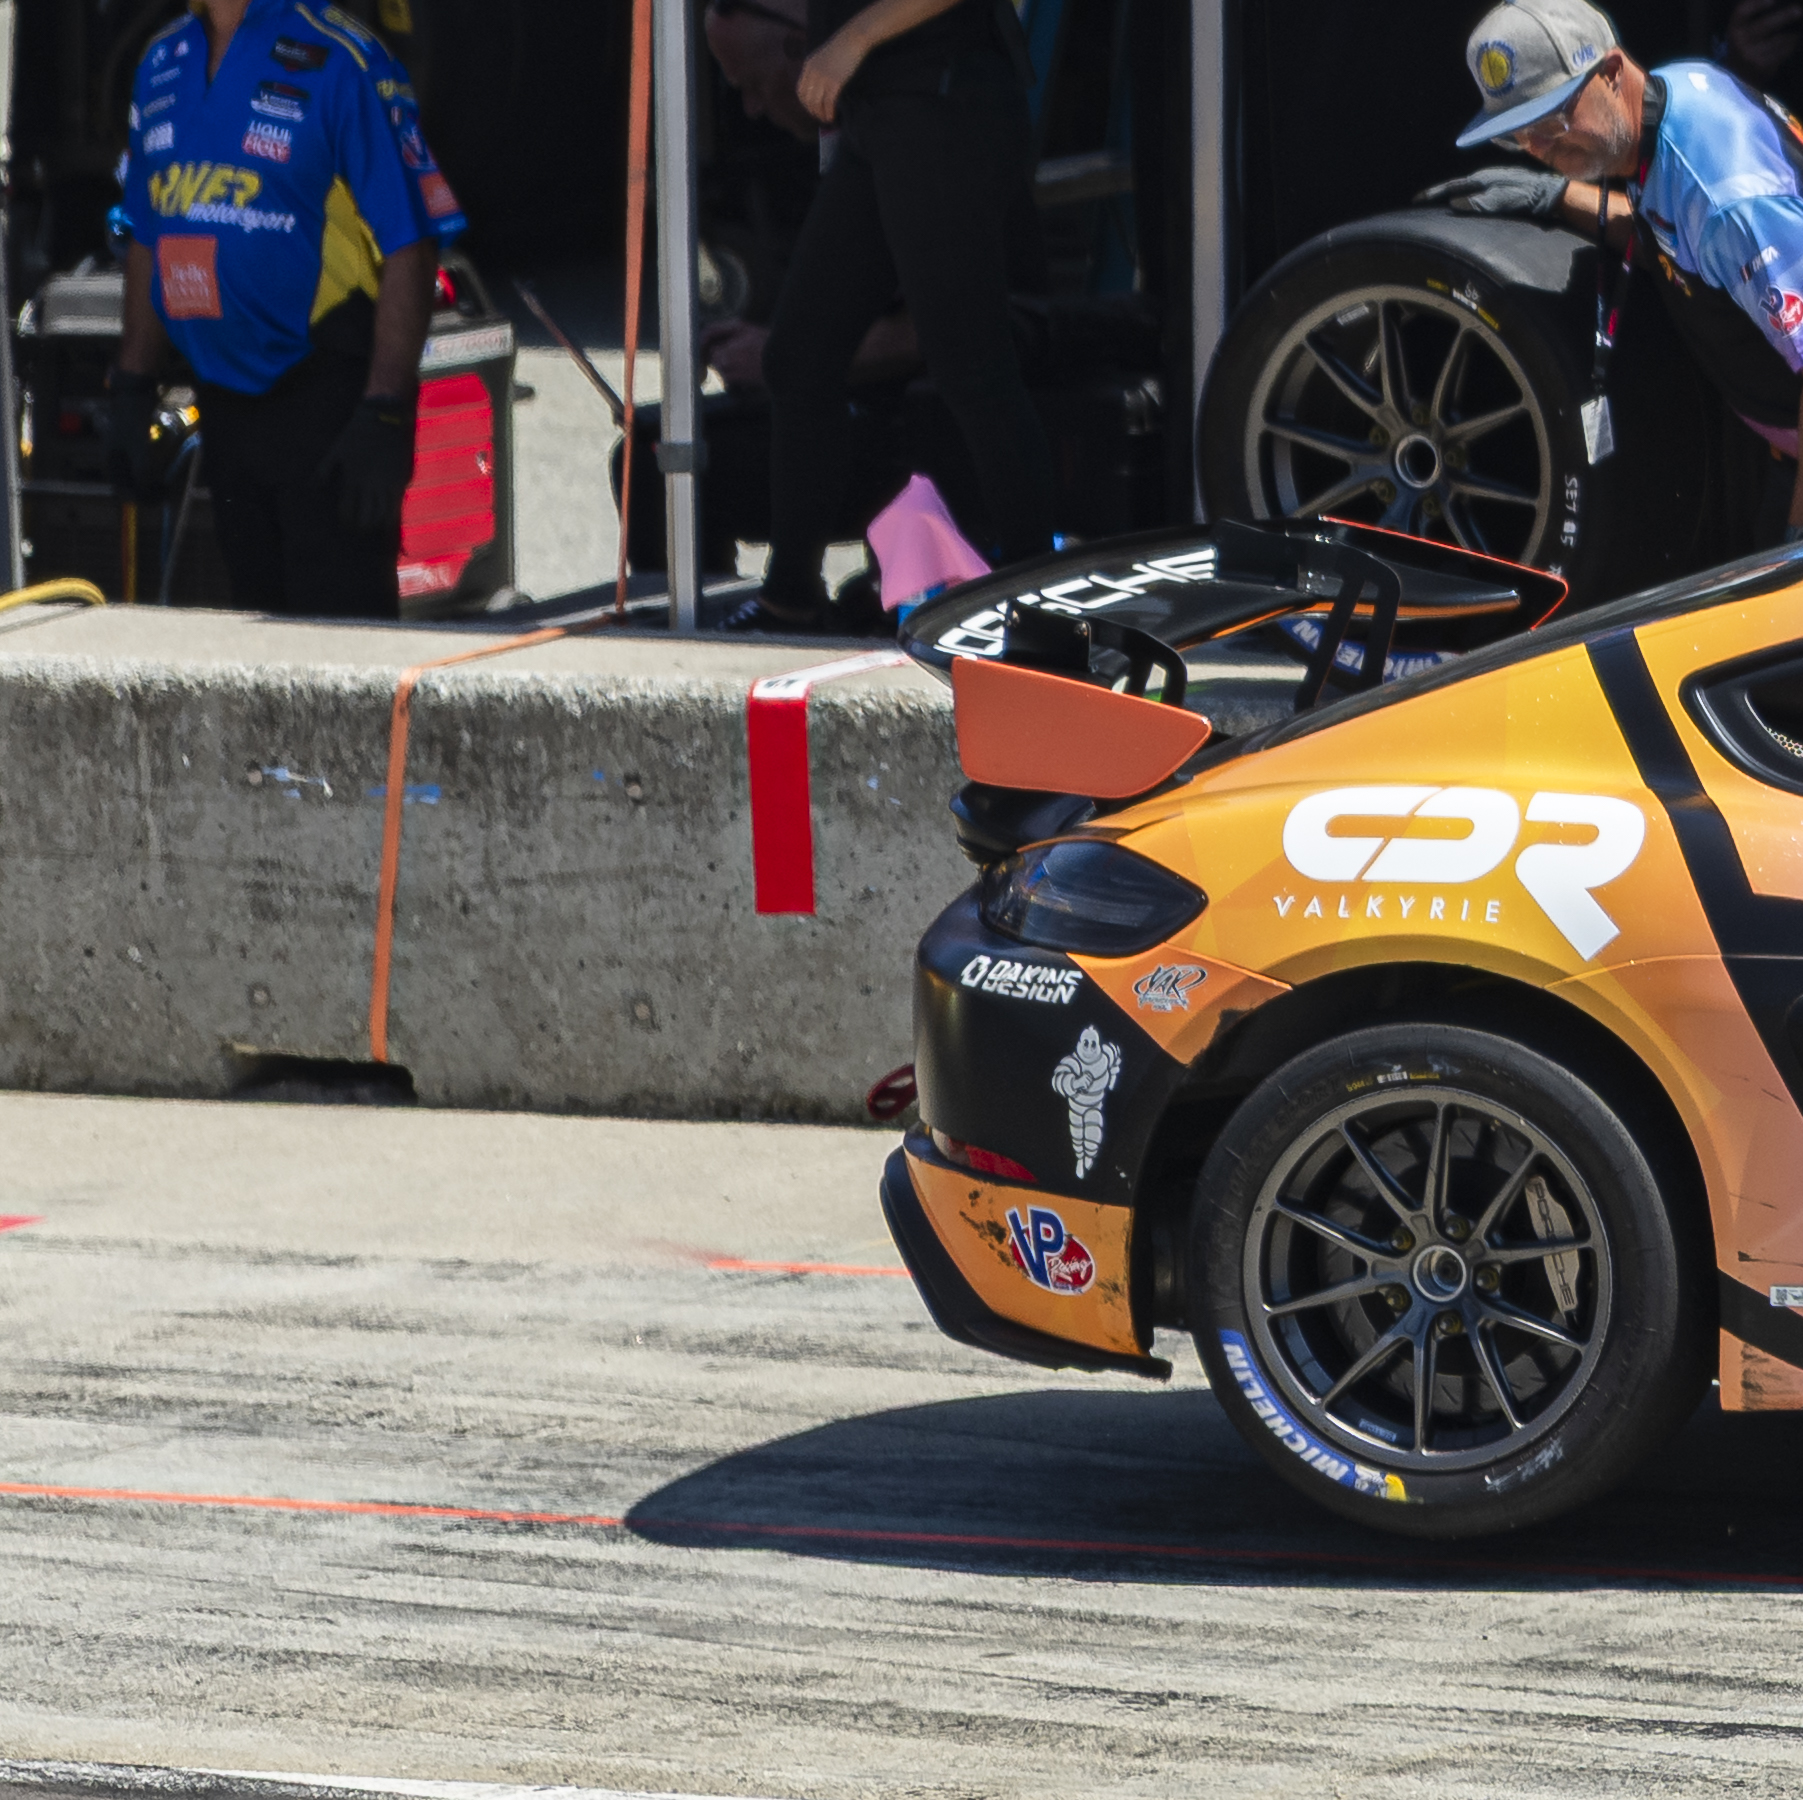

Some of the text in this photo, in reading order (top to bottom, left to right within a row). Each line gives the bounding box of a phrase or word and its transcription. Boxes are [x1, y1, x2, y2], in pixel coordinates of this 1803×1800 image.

[249, 119, 292, 140] LIQUI
[1272, 894, 1501, 924] VALKYRIE
[1005, 1203, 1066, 1291] VP
[1531, 1181, 1576, 1307] PORCHE
[1222, 1341, 1350, 1482] MICHELIN
